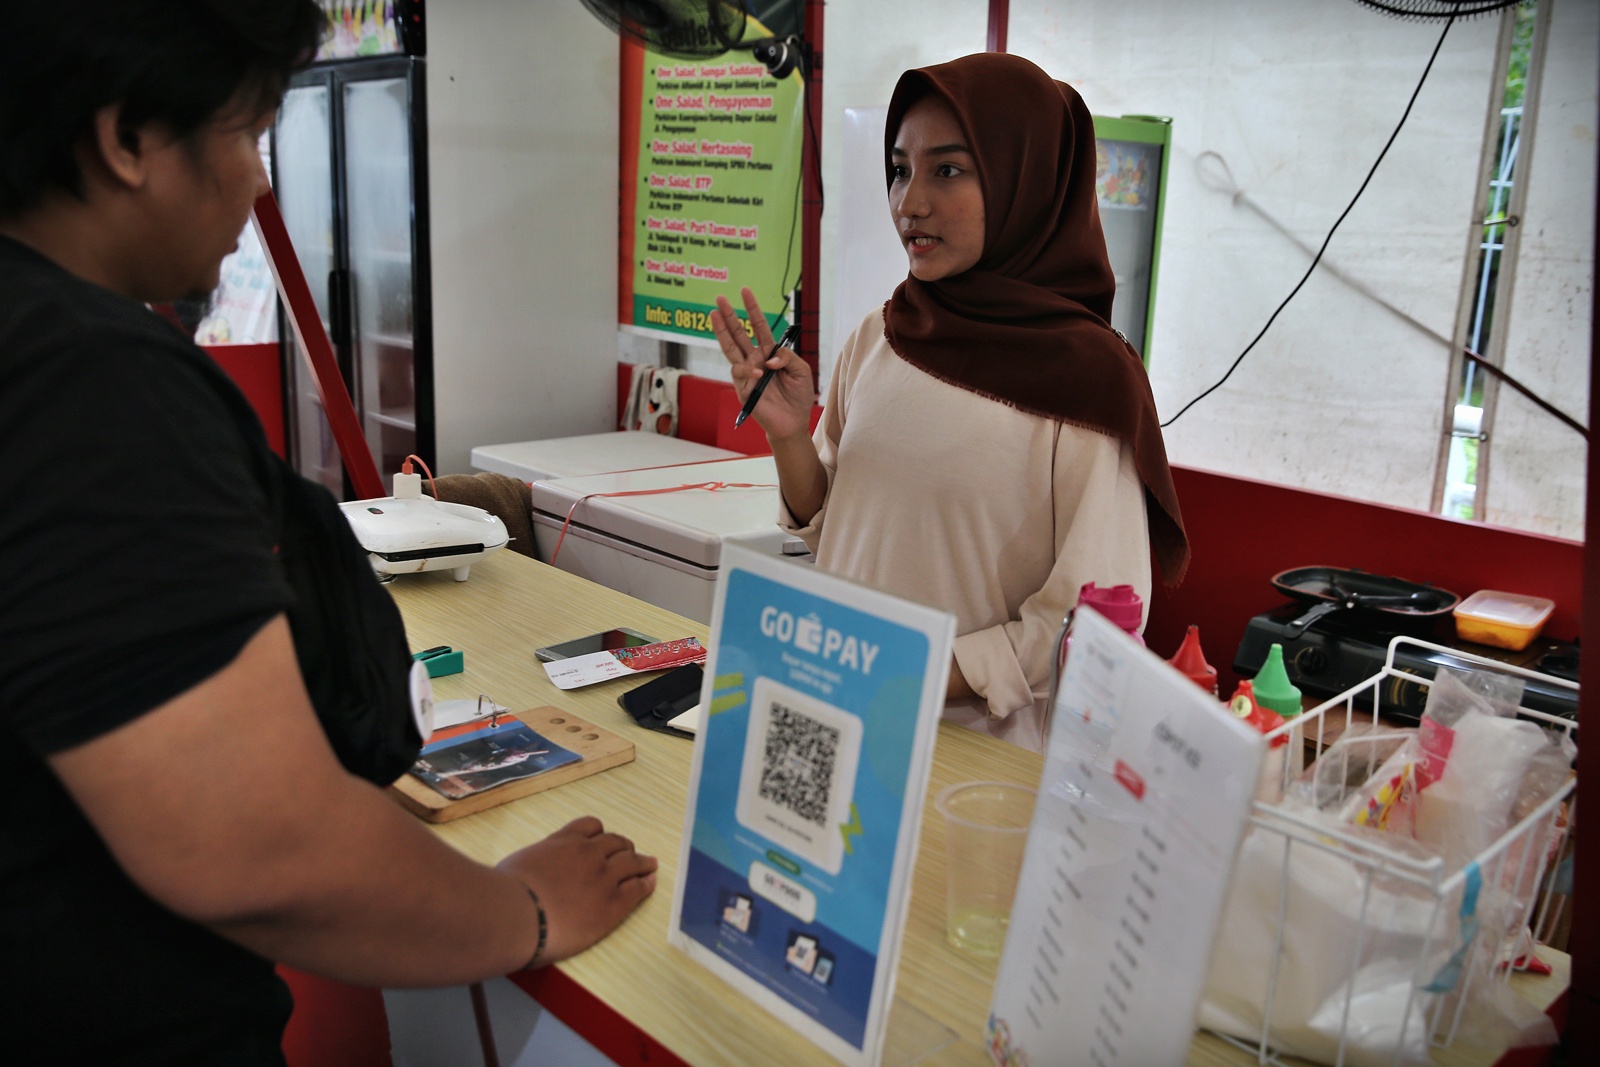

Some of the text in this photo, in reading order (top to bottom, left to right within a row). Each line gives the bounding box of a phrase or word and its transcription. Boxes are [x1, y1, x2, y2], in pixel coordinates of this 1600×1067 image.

[657, 67, 671, 77] One
[674, 66, 696, 79] Salad,
[701, 66, 726, 78] Sungai
[729, 65, 763, 78] Saddang
[657, 82, 679, 90] Parkiran
[656, 95, 772, 111] One Salad, Pengayoman
[655, 113, 676, 121] Parkiran
[653, 140, 752, 159] One Salad, Hertasning
[652, 157, 673, 166] Parkiran
[650, 174, 712, 190] One Salad, BTP
[650, 190, 671, 199] Parkiran
[648, 216, 757, 238] One Salad, Puri Taman sari
[722, 239, 742, 249] Taman
[743, 241, 756, 251] Sari
[646, 259, 728, 280] One Salad, Karebosi
[645, 304, 672, 325] Info:
[760, 605, 794, 643] GO
[822, 629, 879, 675] PAY
